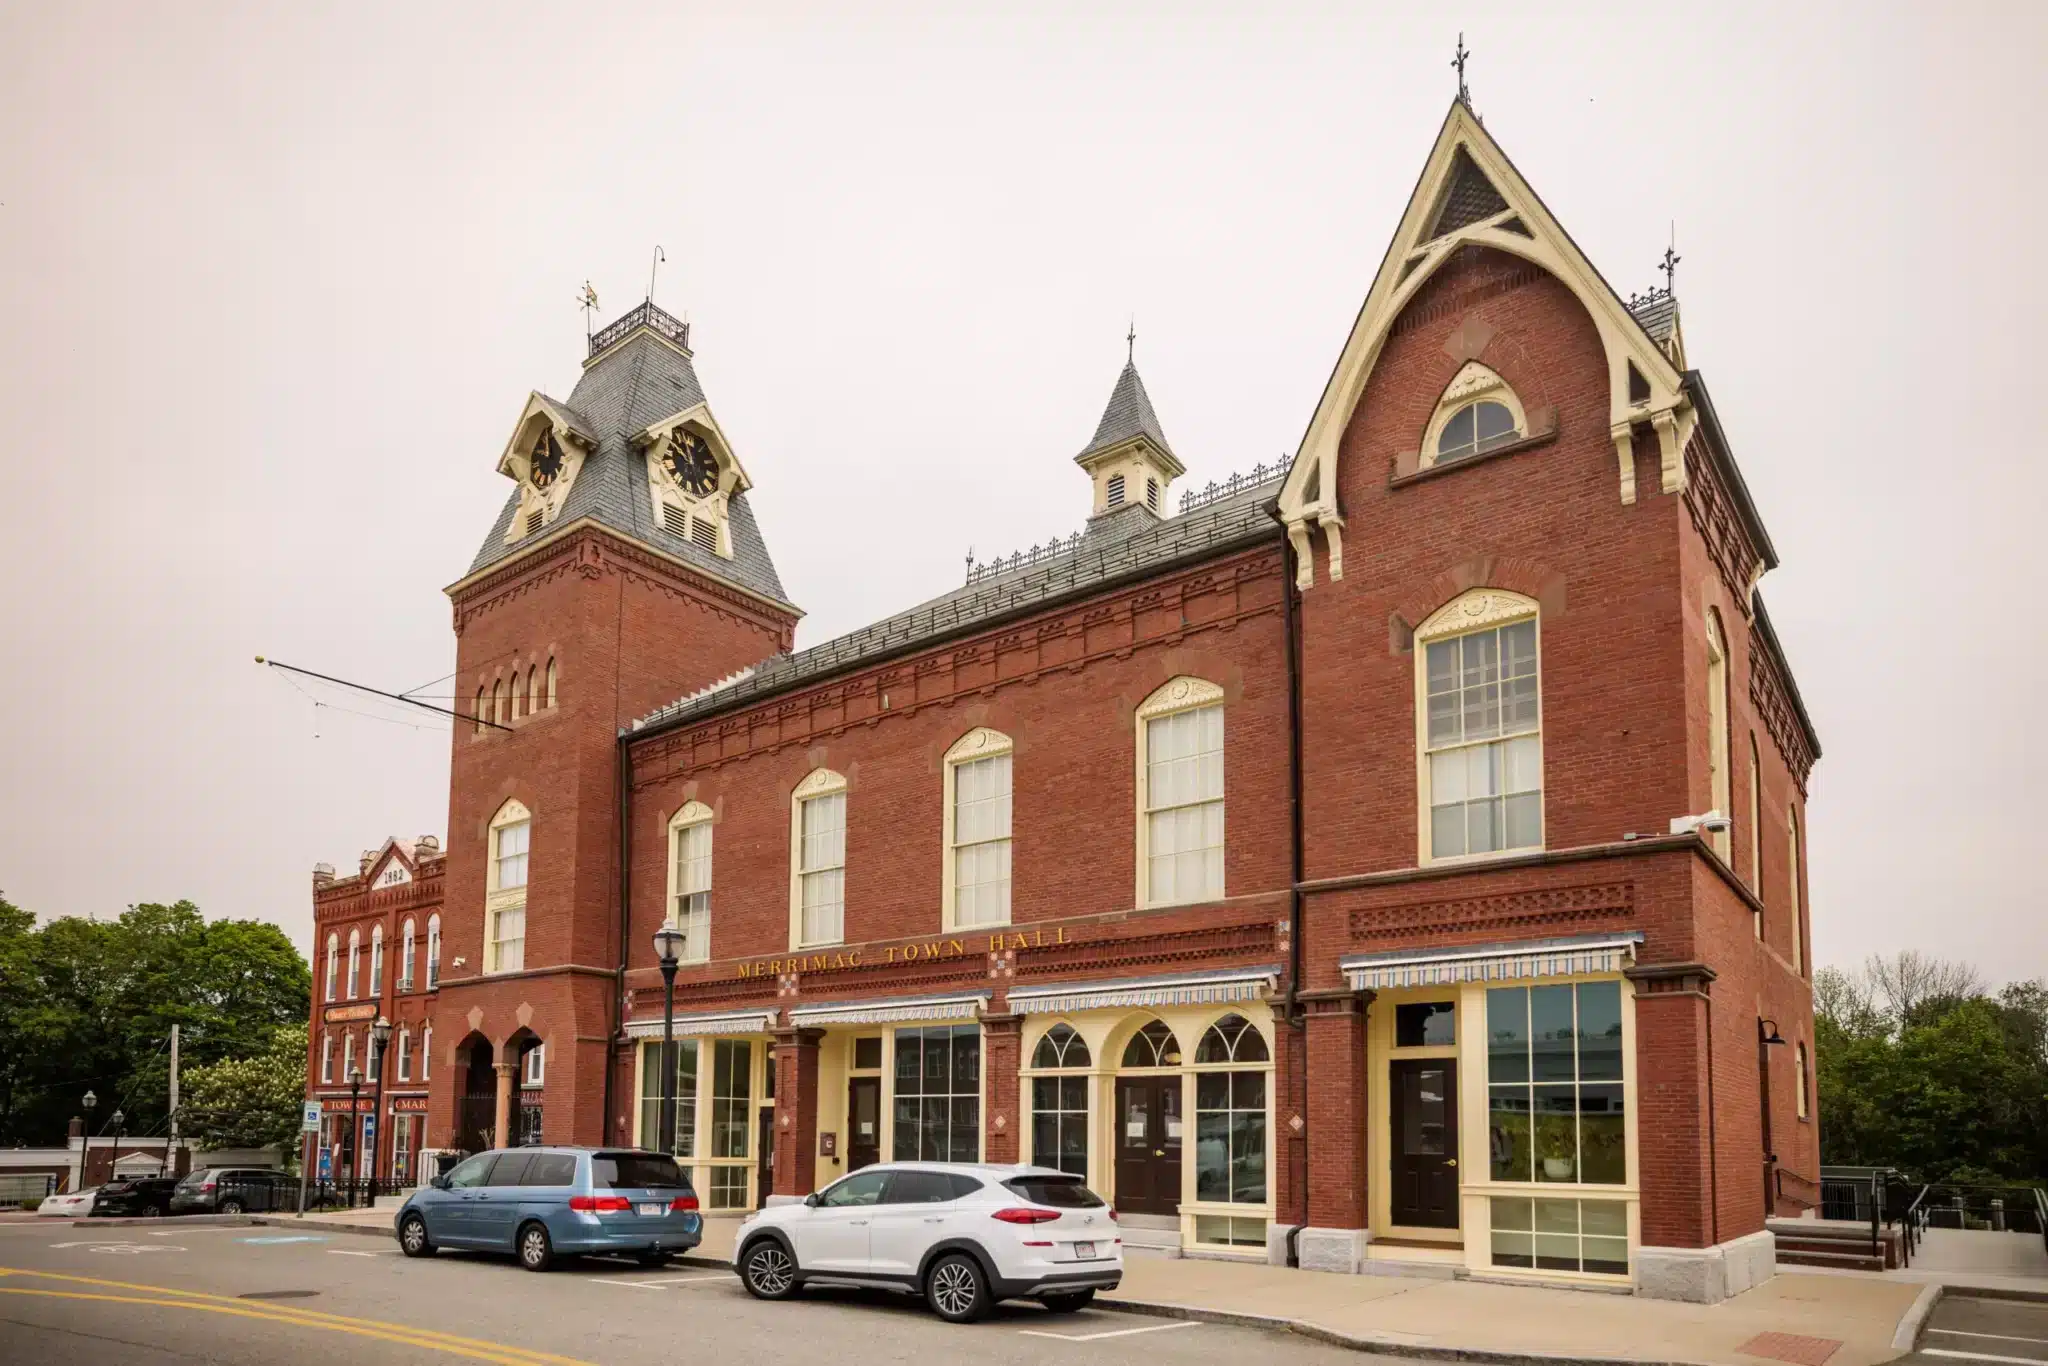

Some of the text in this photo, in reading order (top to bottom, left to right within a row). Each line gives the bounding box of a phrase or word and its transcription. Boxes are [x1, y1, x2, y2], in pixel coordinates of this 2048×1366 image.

[384, 868, 403, 884] 1882
[738, 927, 1072, 977] MERRIMAC TOWN HALL
